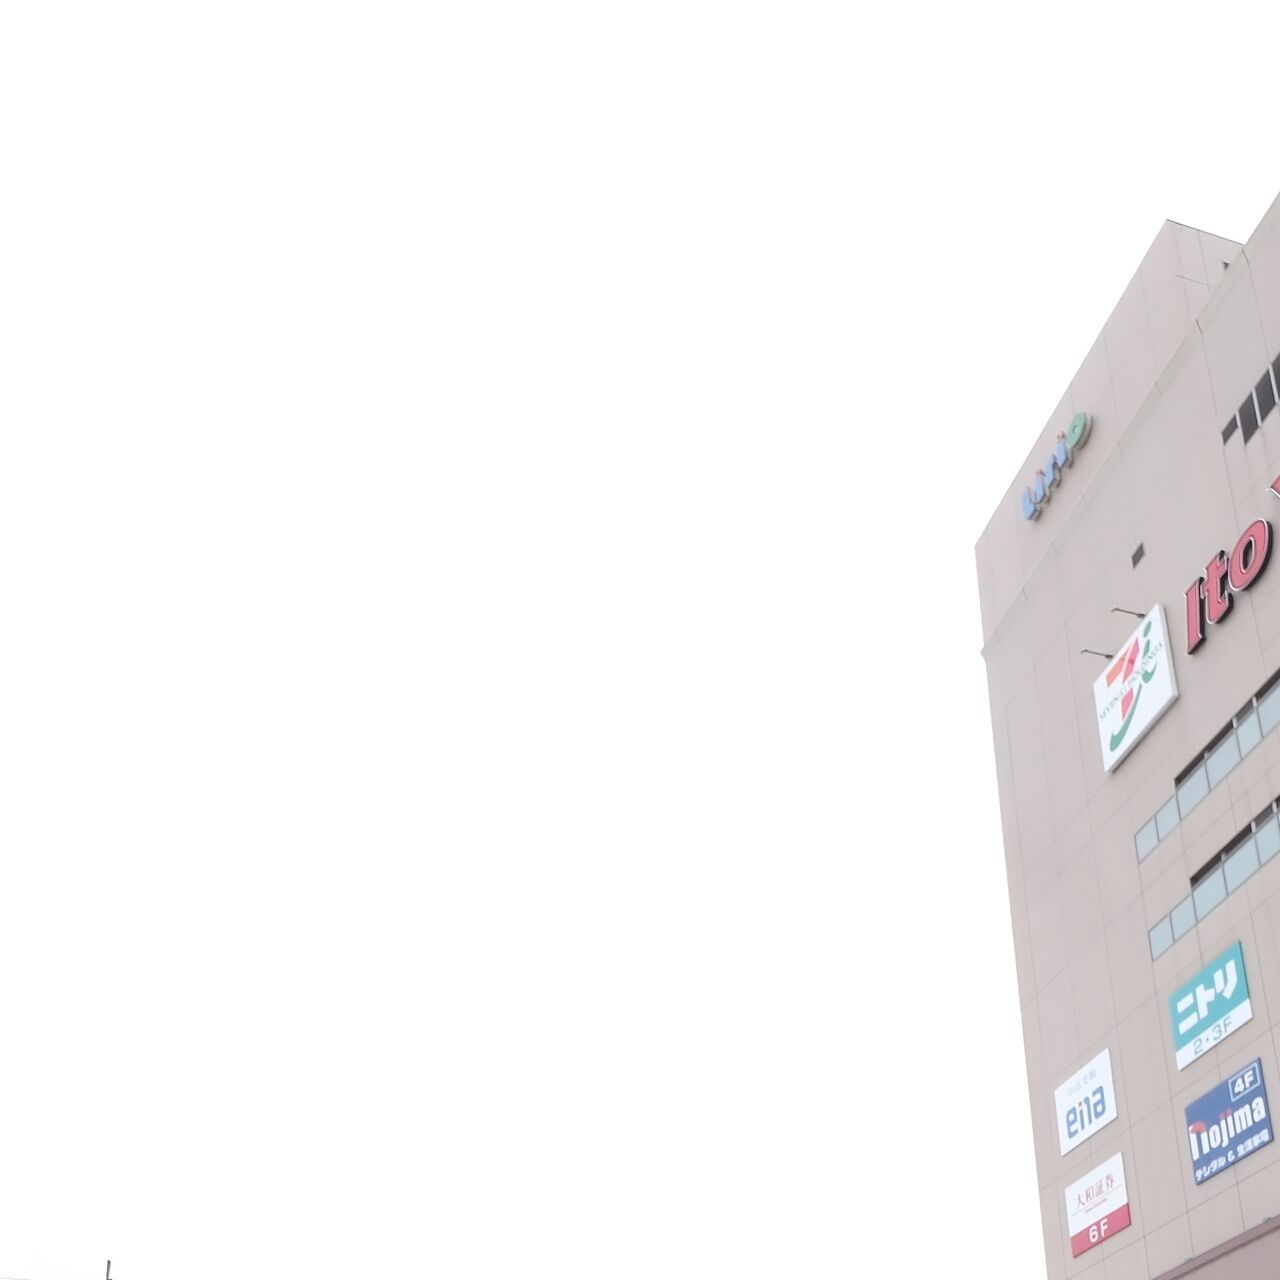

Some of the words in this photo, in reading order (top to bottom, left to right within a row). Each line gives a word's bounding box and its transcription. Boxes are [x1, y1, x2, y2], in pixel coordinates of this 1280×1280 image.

[1184, 518, 1273, 655] Ito
[1176, 958, 1239, 1036] ニトリ
[1232, 1069, 1255, 1095] 4F
[1188, 1095, 1268, 1162] nojima
[1088, 1218, 1110, 1244] 6F
